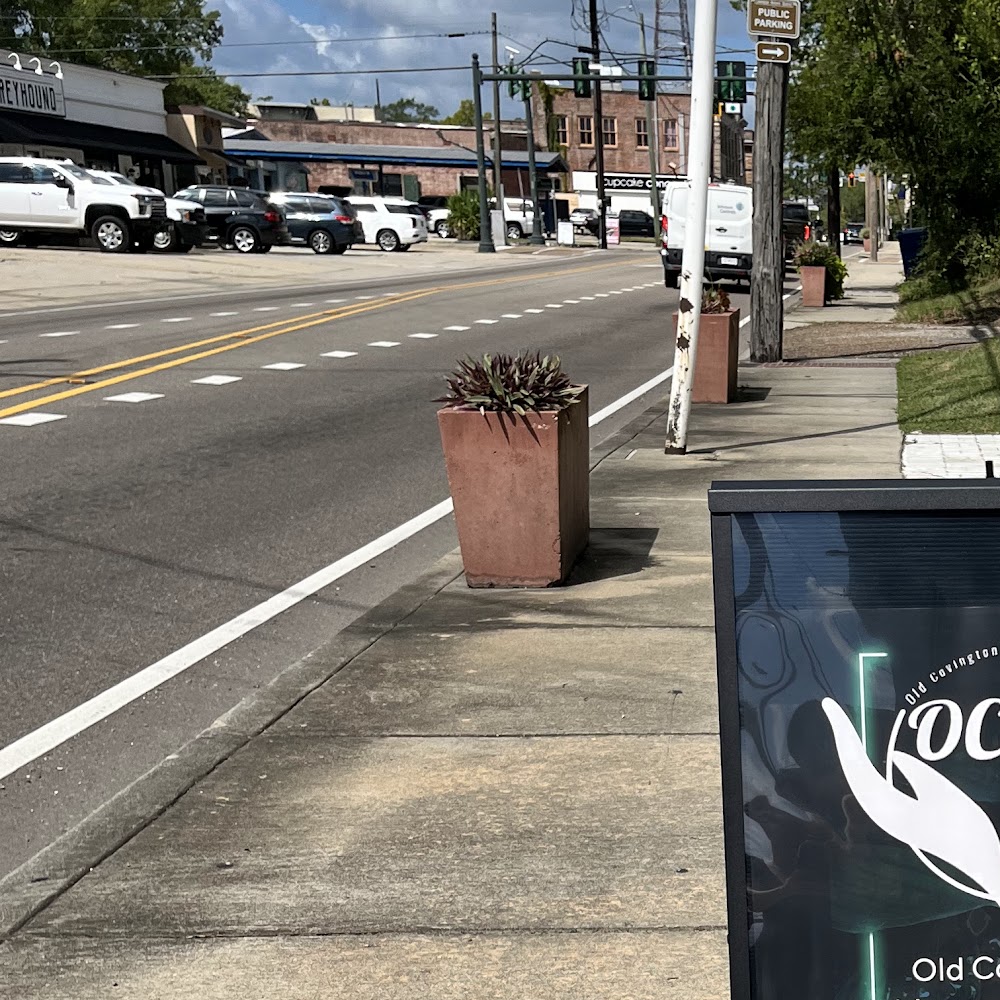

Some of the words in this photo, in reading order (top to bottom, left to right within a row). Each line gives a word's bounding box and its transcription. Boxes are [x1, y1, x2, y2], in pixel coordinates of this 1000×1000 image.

[757, 7, 790, 19] PUBLIC
[754, 18, 793, 30] PARKING
[904, 681, 927, 706] Old
[929, 645, 999, 683] Covington
[912, 957, 965, 982] Old
